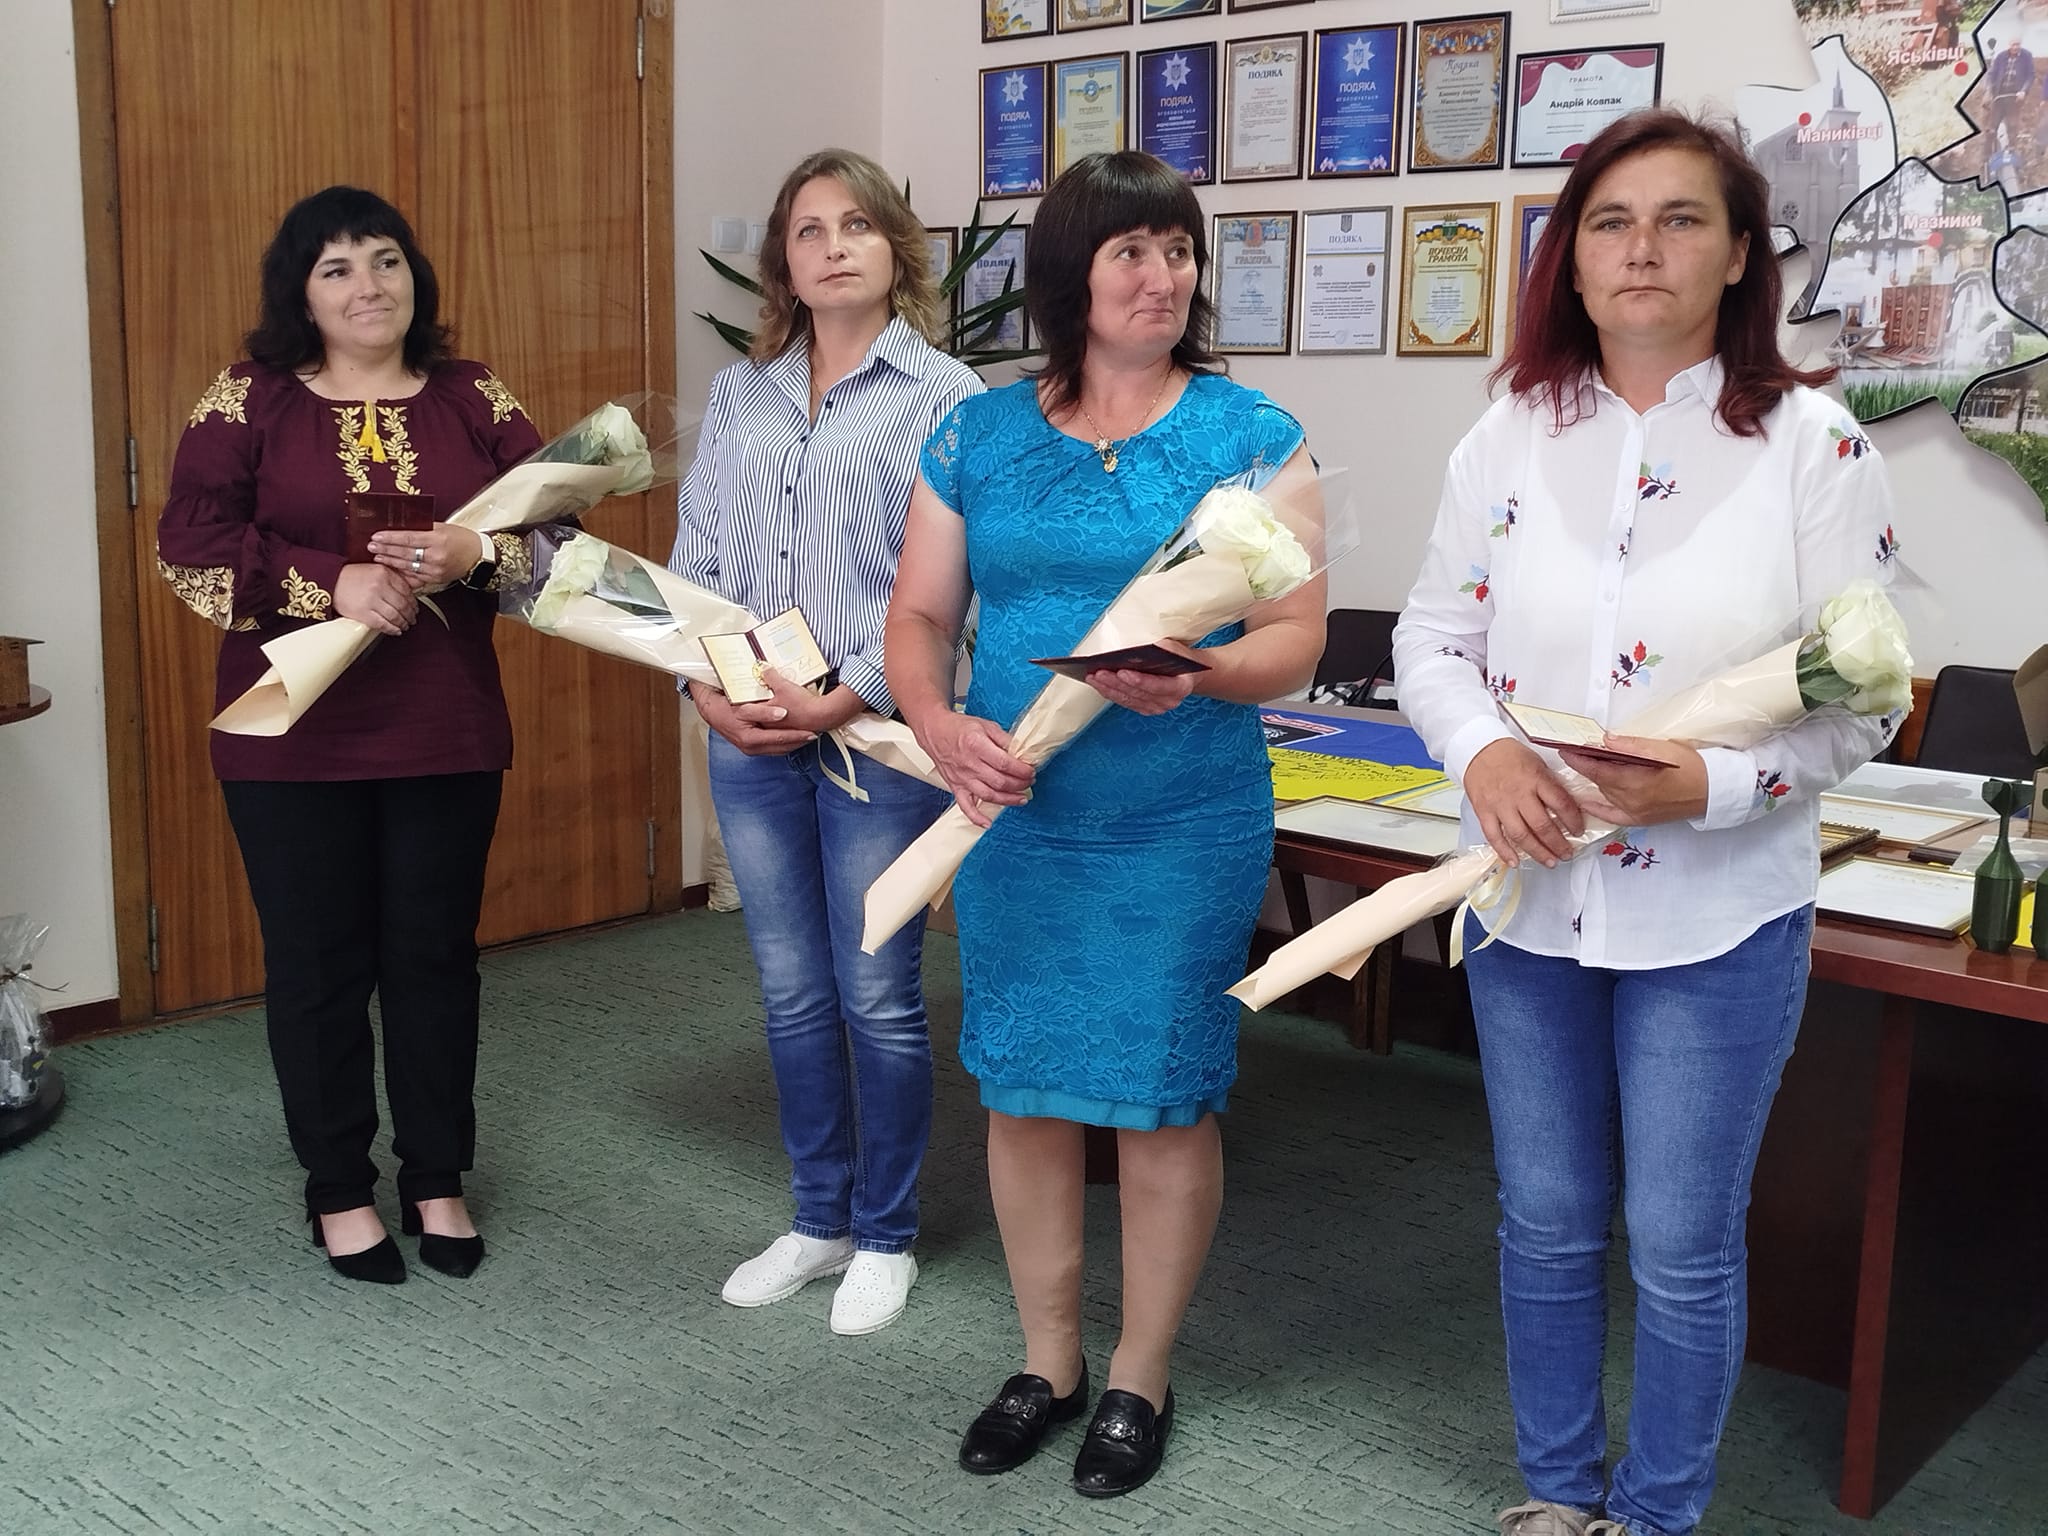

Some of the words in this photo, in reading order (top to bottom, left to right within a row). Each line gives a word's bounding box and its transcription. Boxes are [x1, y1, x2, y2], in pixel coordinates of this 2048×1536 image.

[1887, 45, 1965, 66] Яськівці
[1442, 57, 1480, 74] Подяка
[1248, 68, 1283, 80] ПОДЯКА
[1569, 75, 1604, 83] ГРАМОТА
[1339, 81, 1377, 94] ПОДЯКА
[1160, 96, 1194, 108] ПОДЯКА
[1549, 97, 1585, 110] Андрій
[1586, 96, 1623, 107] Ковпак
[1000, 111, 1031, 122] ПОДЯКА
[1796, 122, 1883, 144] Маниківці
[1903, 212, 1982, 229] Мазники
[1328, 235, 1362, 244] ПОДЯКА
[1428, 246, 1469, 256] ПОЧЕСНА
[1235, 255, 1273, 265] ГРАМОТА
[1428, 254, 1469, 263] ГРАМОТА
